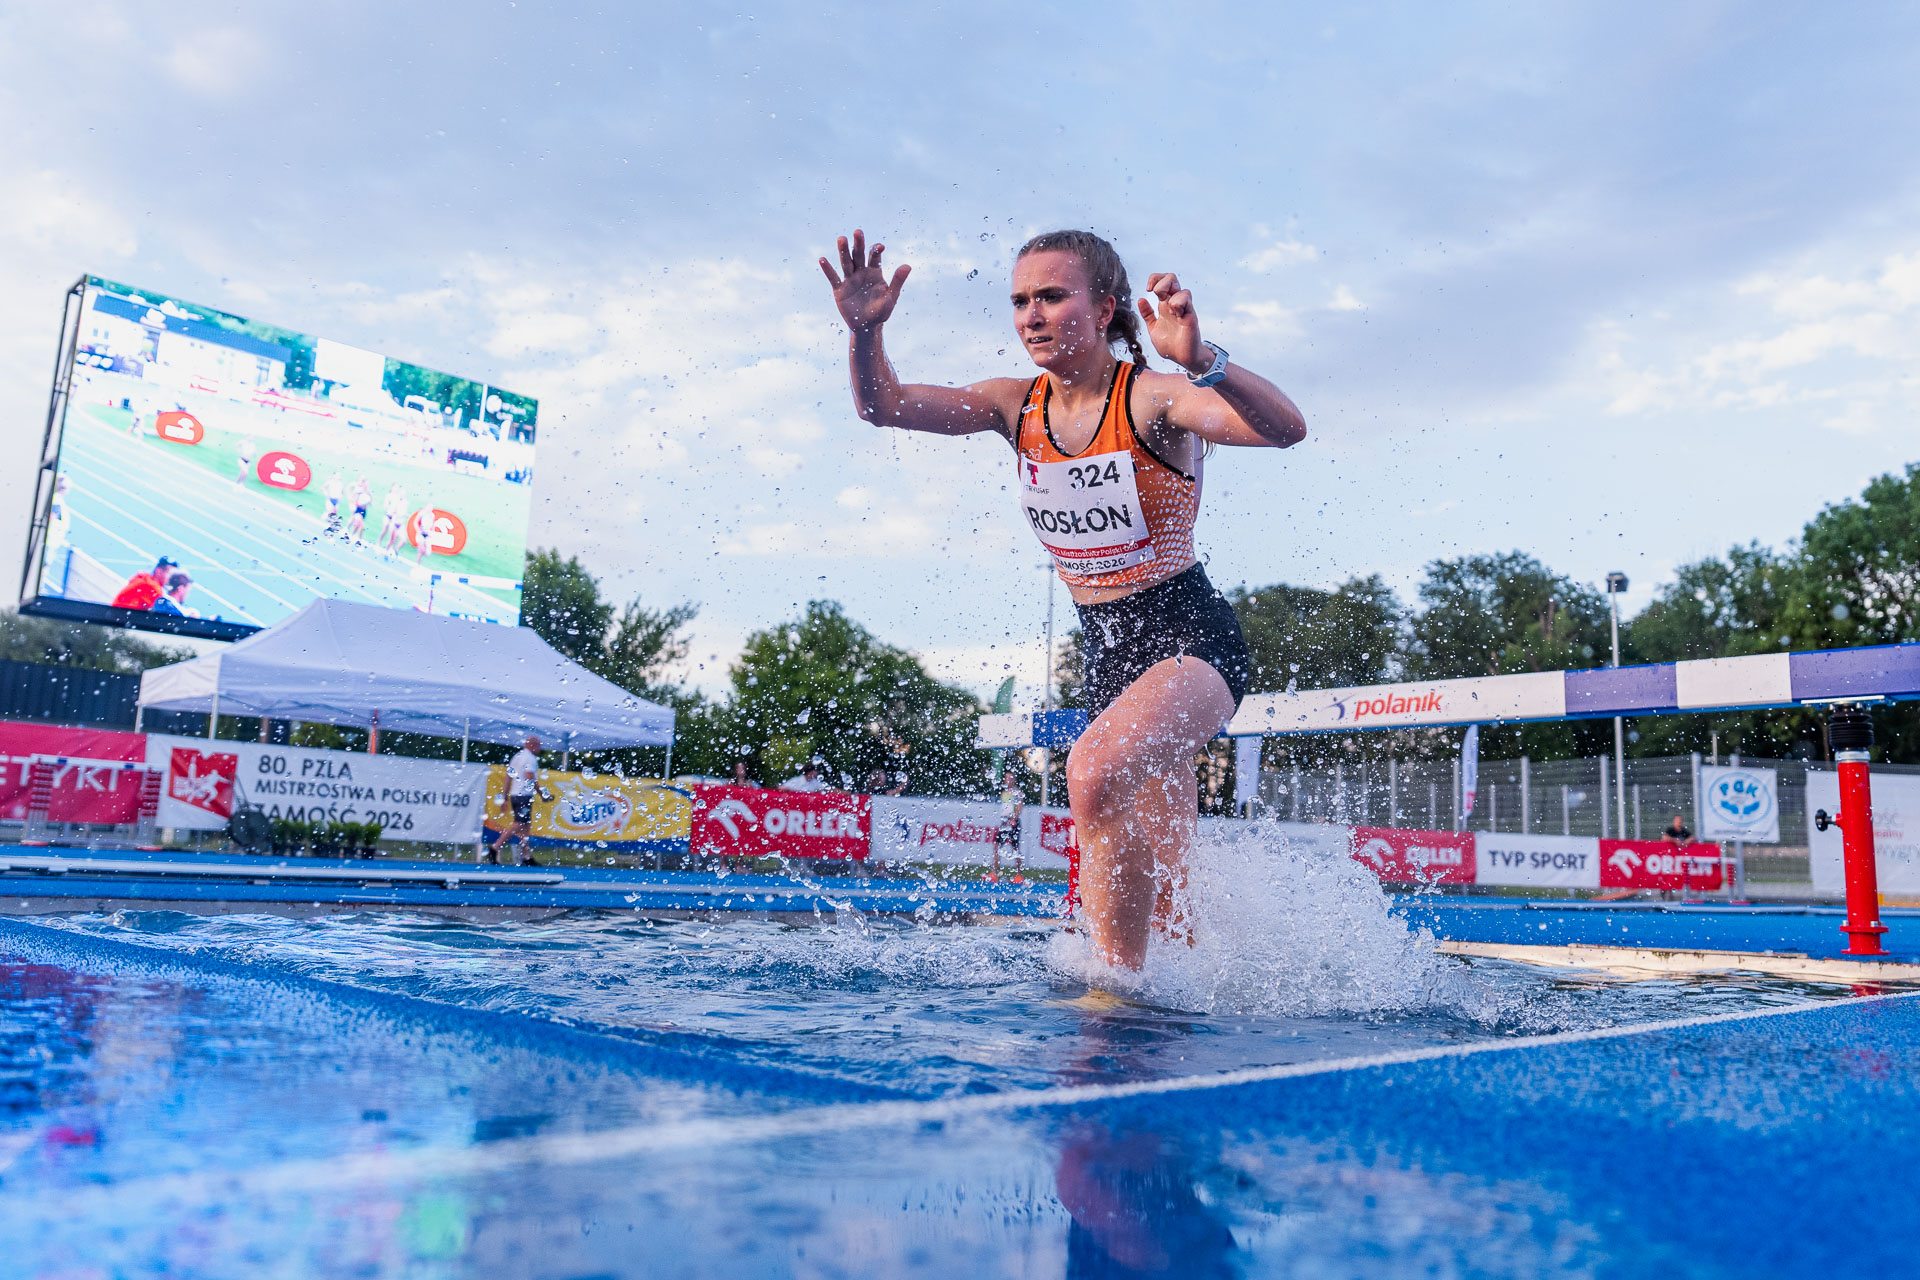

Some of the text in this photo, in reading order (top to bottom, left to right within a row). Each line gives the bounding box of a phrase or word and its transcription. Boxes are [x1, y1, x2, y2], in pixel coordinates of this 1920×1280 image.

[1068, 460, 1121, 490] 324
[1027, 504, 1132, 534] ROSŁON
[1100, 546, 1123, 556] Polski
[1354, 691, 1445, 721] polanik
[302, 758, 353, 780] PZLA
[254, 779, 471, 808] MISTRZOSTWA POLSKI U20
[365, 809, 414, 831] 2026
[763, 808, 859, 839] ORLEN
[1488, 849, 1588, 869] TVP SPORT
